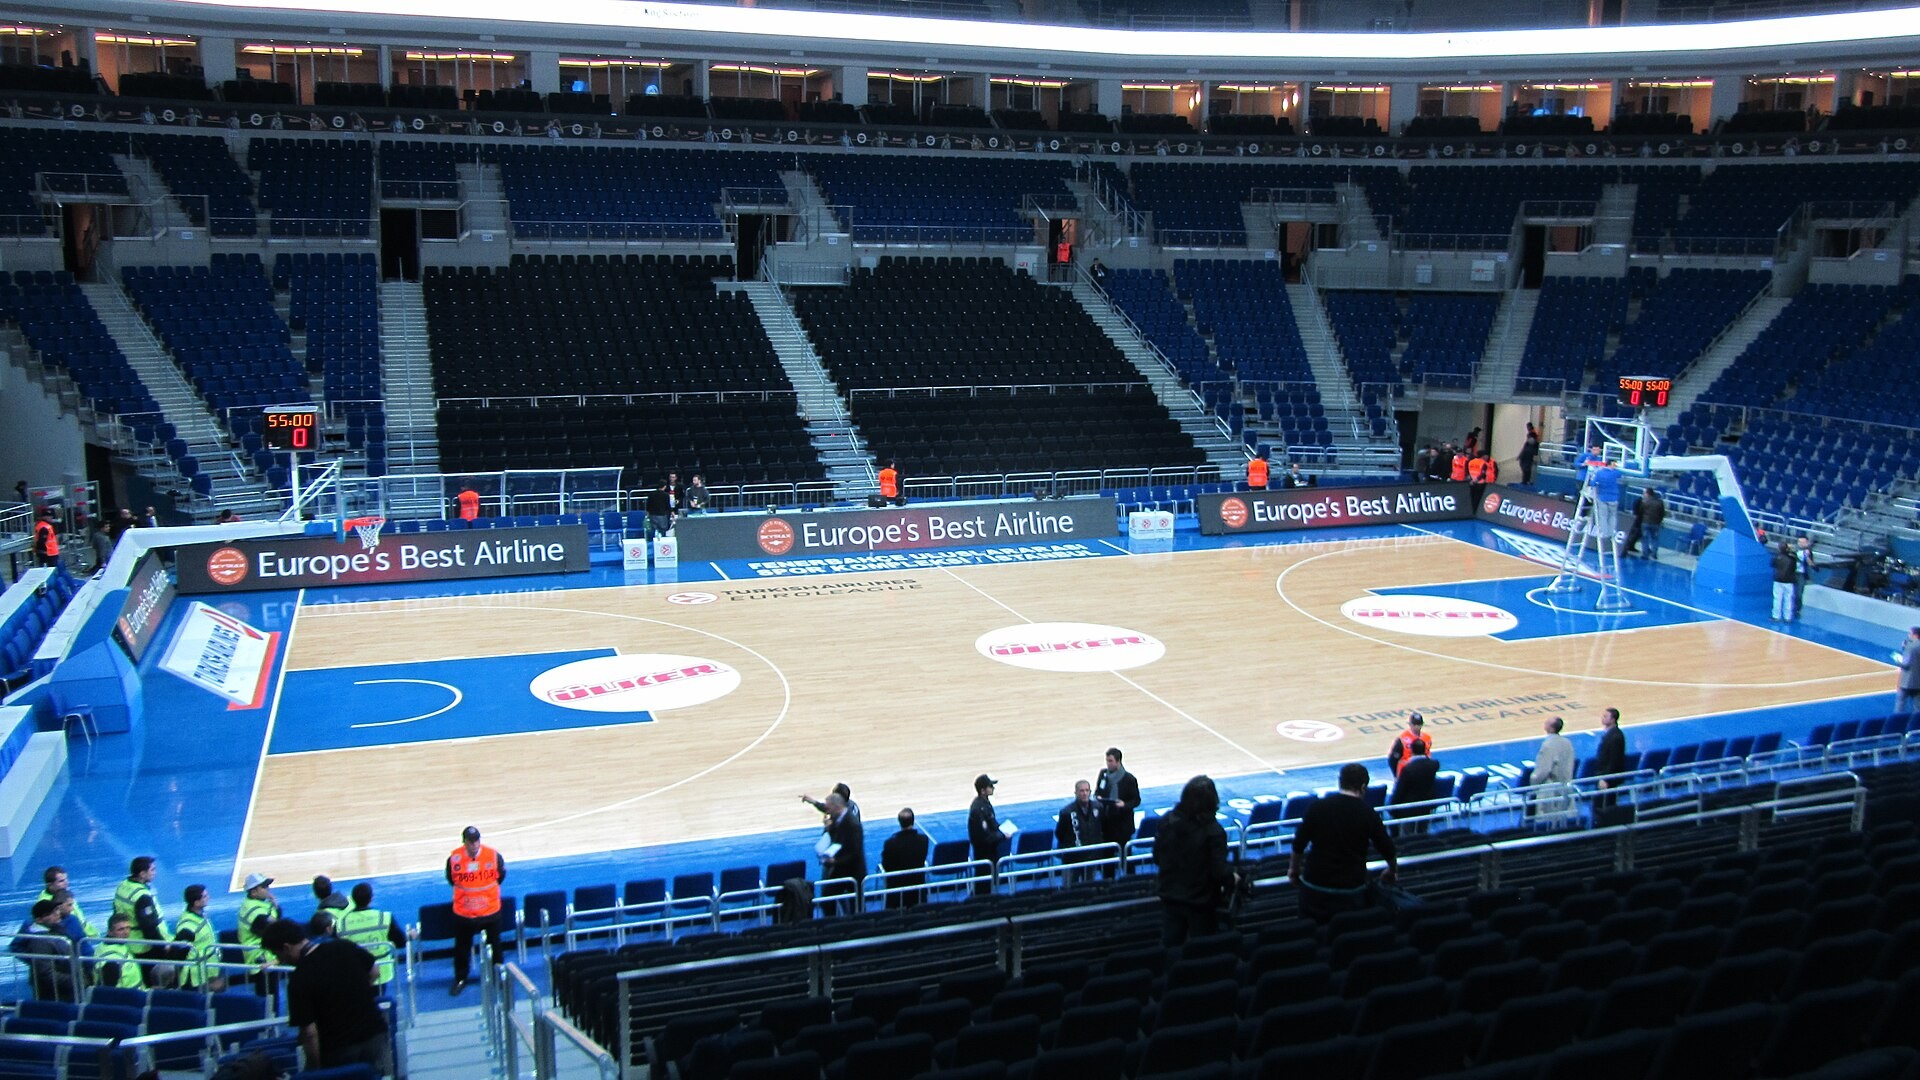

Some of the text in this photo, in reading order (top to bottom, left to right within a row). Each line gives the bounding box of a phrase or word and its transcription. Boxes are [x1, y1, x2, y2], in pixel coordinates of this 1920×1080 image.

[268, 414, 313, 427] 55:00
[293, 428, 308, 447] 0
[1252, 491, 1456, 524] Europe's Best Airline
[1499, 498, 1550, 525] Europe's
[803, 518, 920, 550] Europe's
[928, 514, 987, 540] Best
[994, 510, 1074, 536] Airline
[258, 547, 390, 579] Europe's
[401, 543, 465, 570] Best
[474, 538, 564, 566] Airline
[730, 584, 923, 601] EUROLEAGUE
[1357, 701, 1588, 735] EUOLEAGUE
